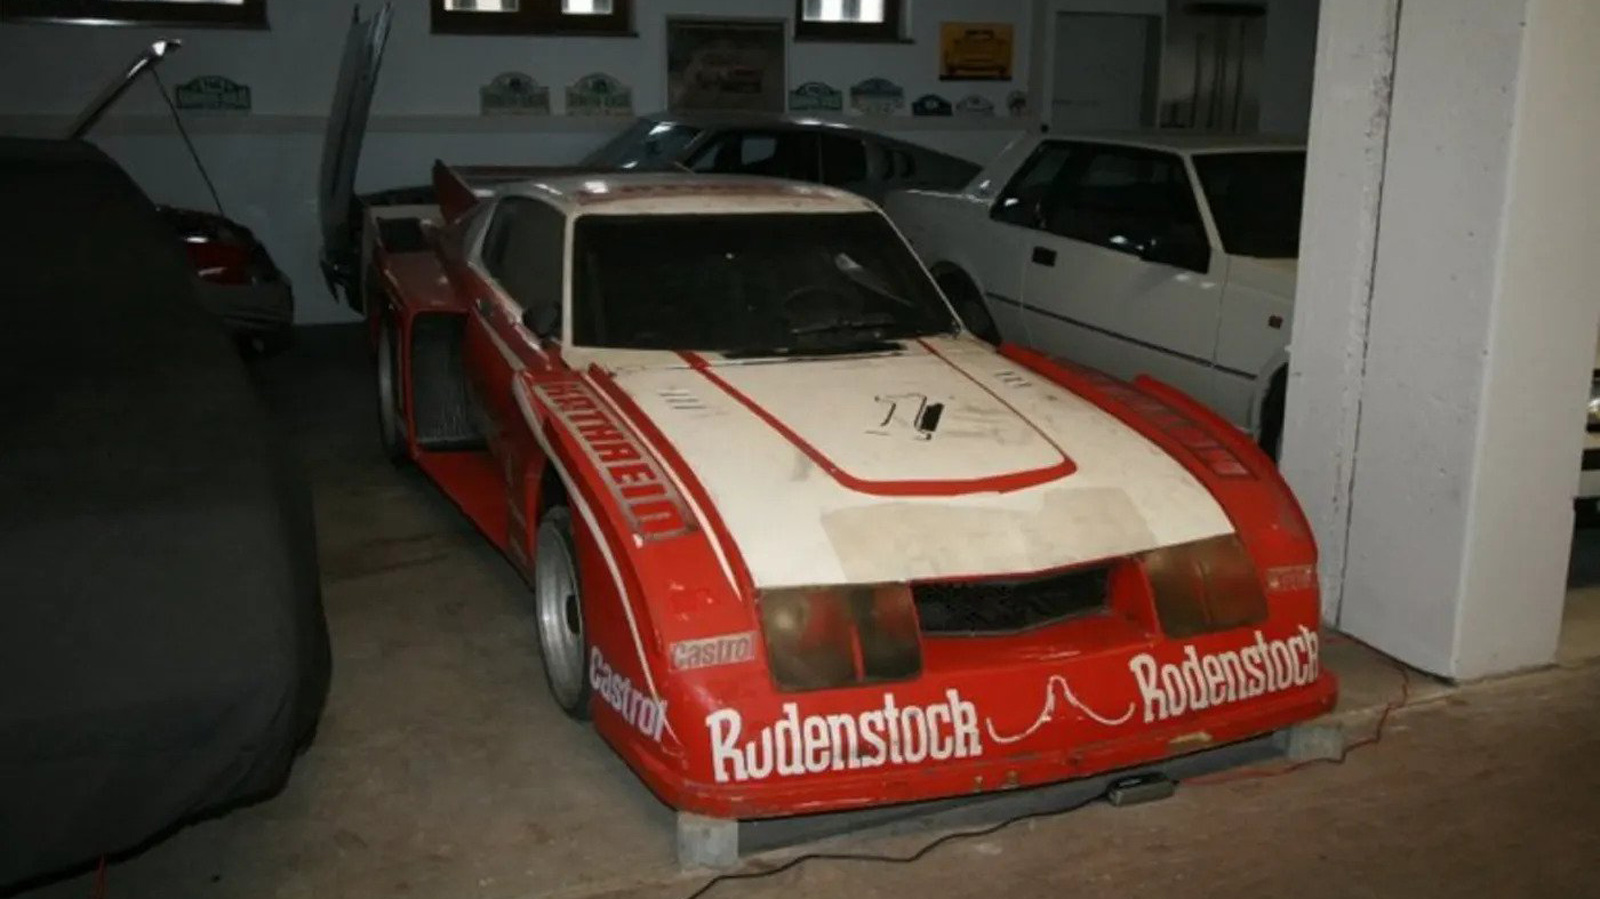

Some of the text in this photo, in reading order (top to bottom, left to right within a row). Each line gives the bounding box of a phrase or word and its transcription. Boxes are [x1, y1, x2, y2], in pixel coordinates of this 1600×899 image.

[589, 646, 668, 742] Castrol
[672, 634, 756, 669] Castrol
[1129, 625, 1319, 723] Rodenstock
